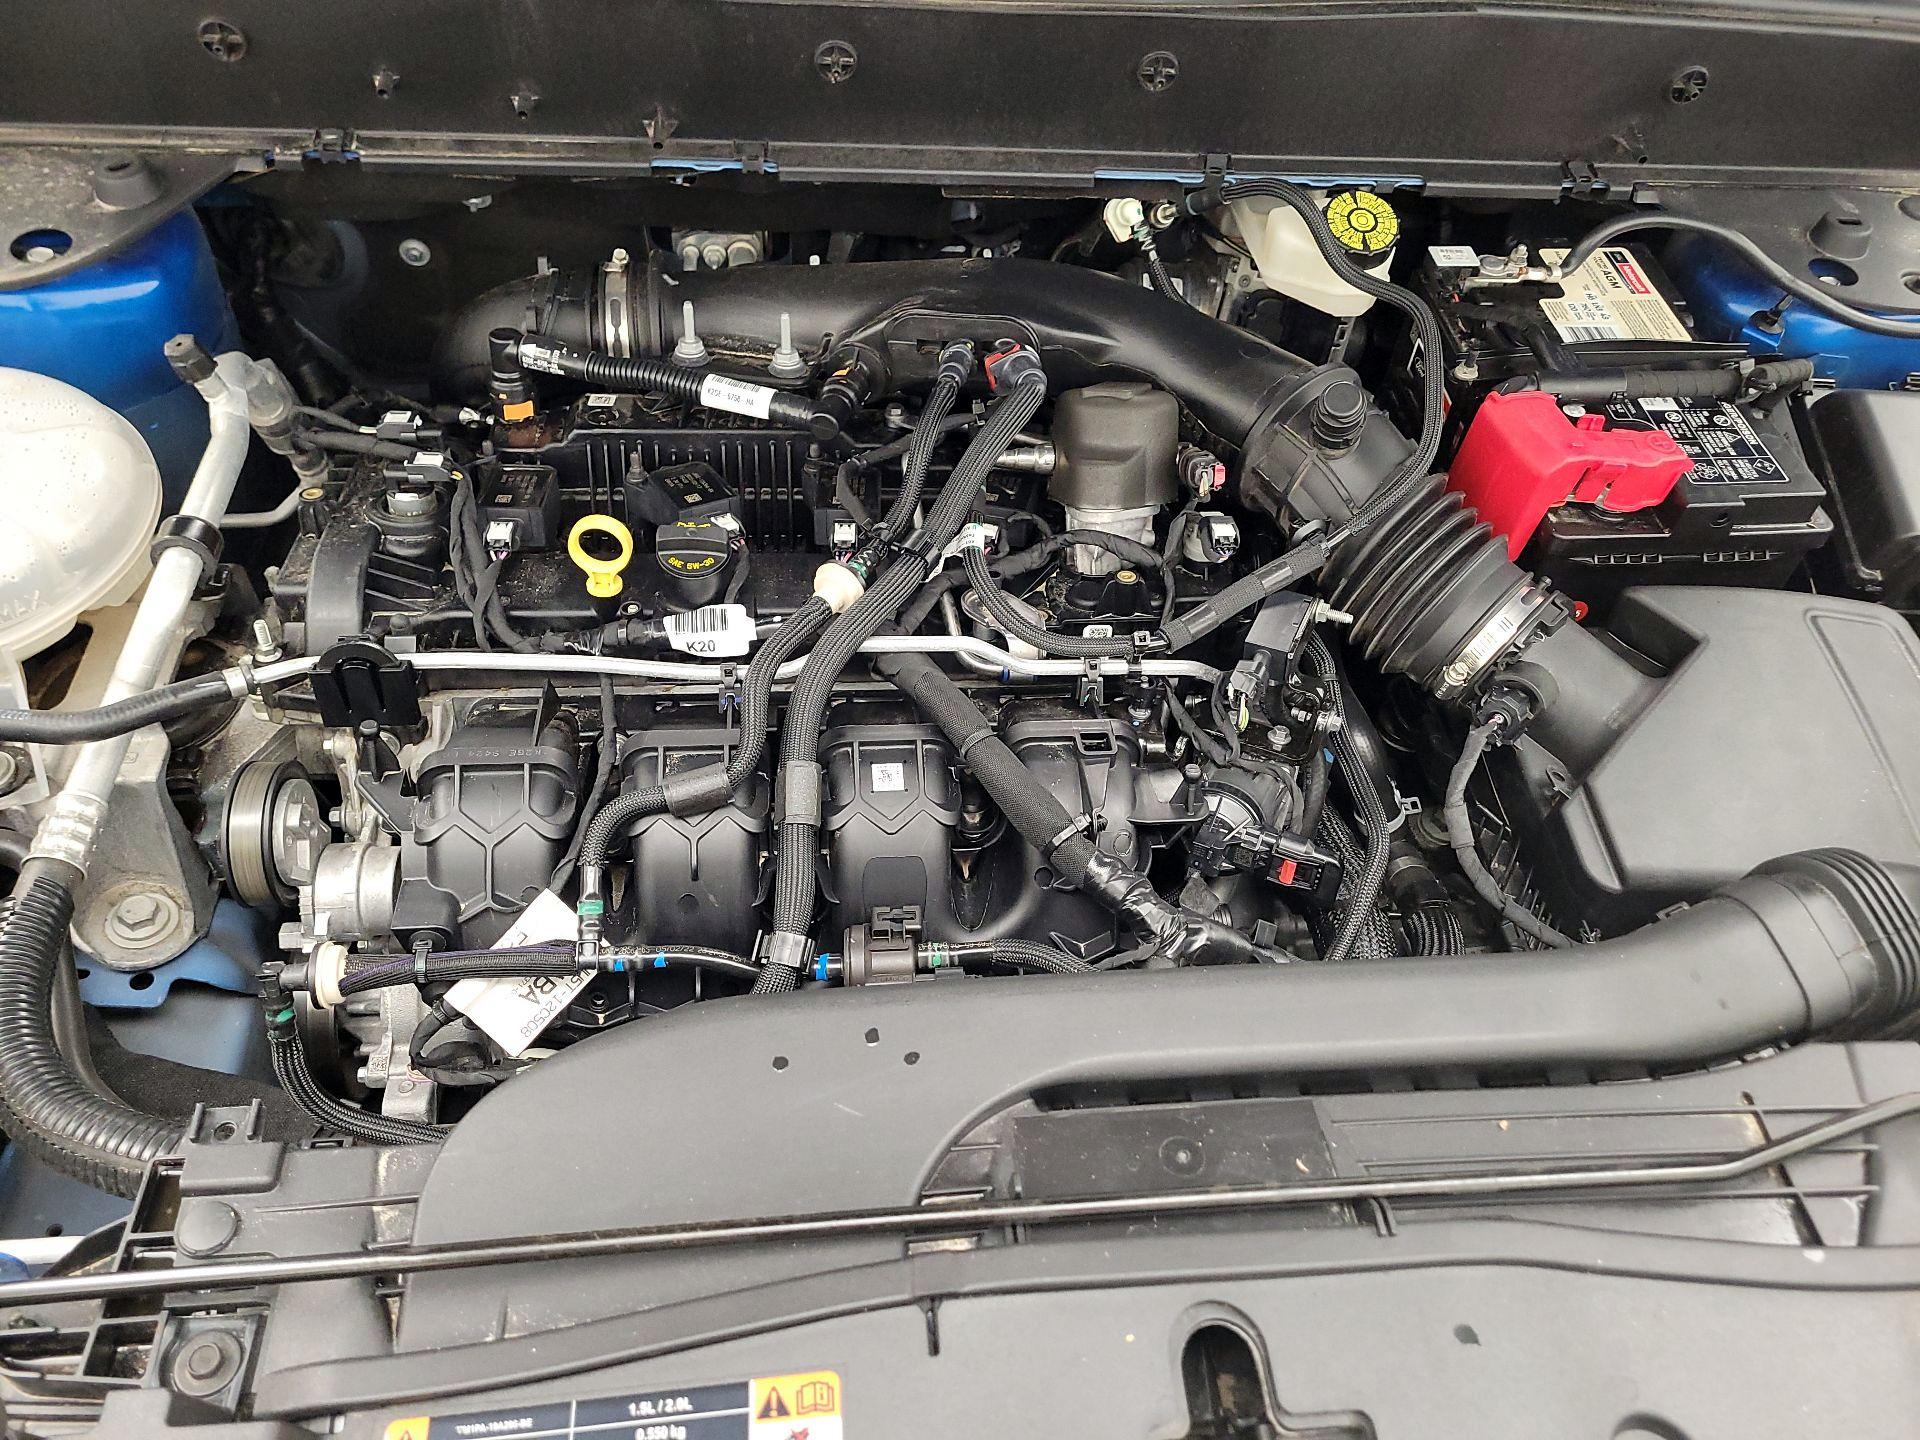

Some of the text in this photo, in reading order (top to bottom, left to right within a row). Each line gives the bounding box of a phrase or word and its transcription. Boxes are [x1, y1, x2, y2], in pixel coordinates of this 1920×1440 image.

[1602, 270, 1622, 289] AGM
[1720, 401, 1759, 445] GER/POISON
[668, 557, 715, 570] SAE 5W-30
[686, 639, 716, 652] K20
[655, 945, 695, 953] 05/02/22
[518, 975, 565, 1005] BA
[657, 1399, 664, 1414] /
[664, 1397, 694, 1413] 2.0L
[670, 1424, 687, 1440] kg
